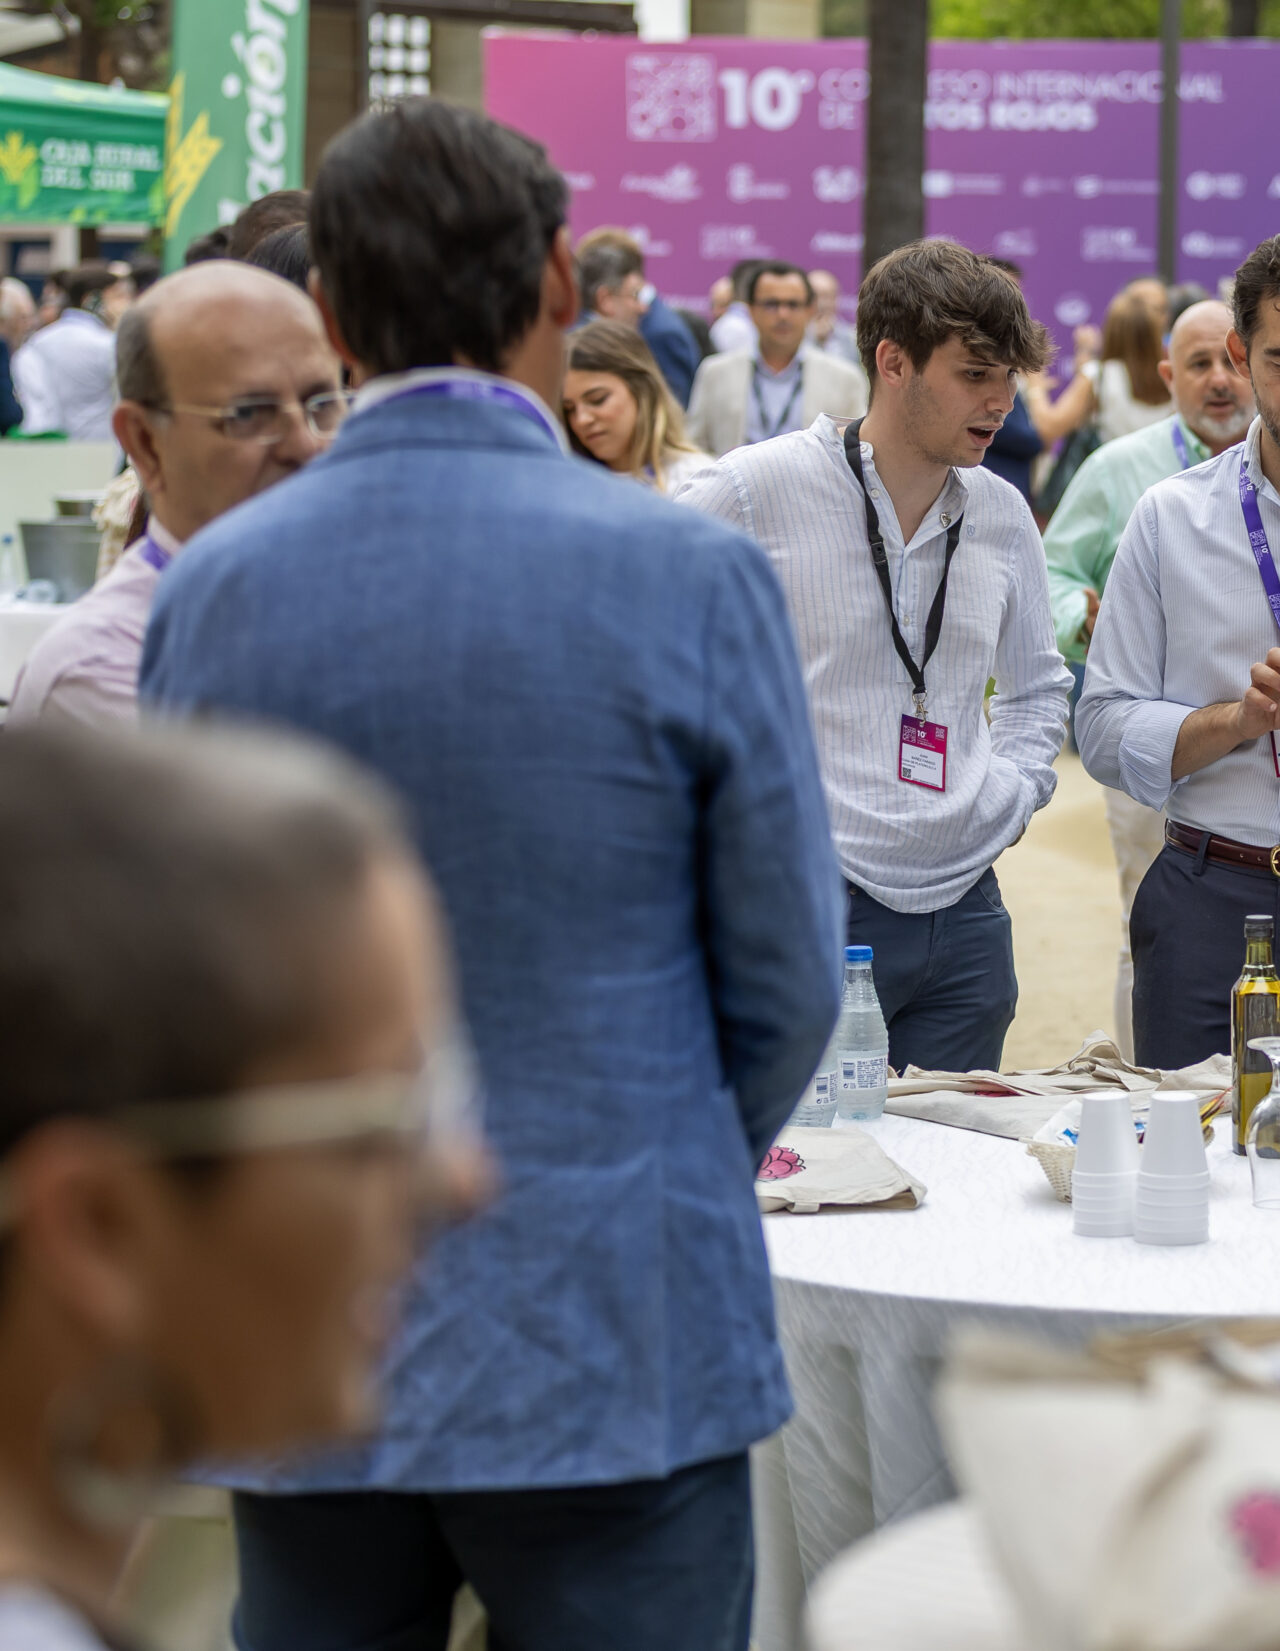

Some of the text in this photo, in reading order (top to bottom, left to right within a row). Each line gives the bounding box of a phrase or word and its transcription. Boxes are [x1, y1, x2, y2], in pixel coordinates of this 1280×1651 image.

[818, 68, 992, 101] COESO
[818, 100, 862, 130] DE
[989, 100, 1099, 132] ROJOS
